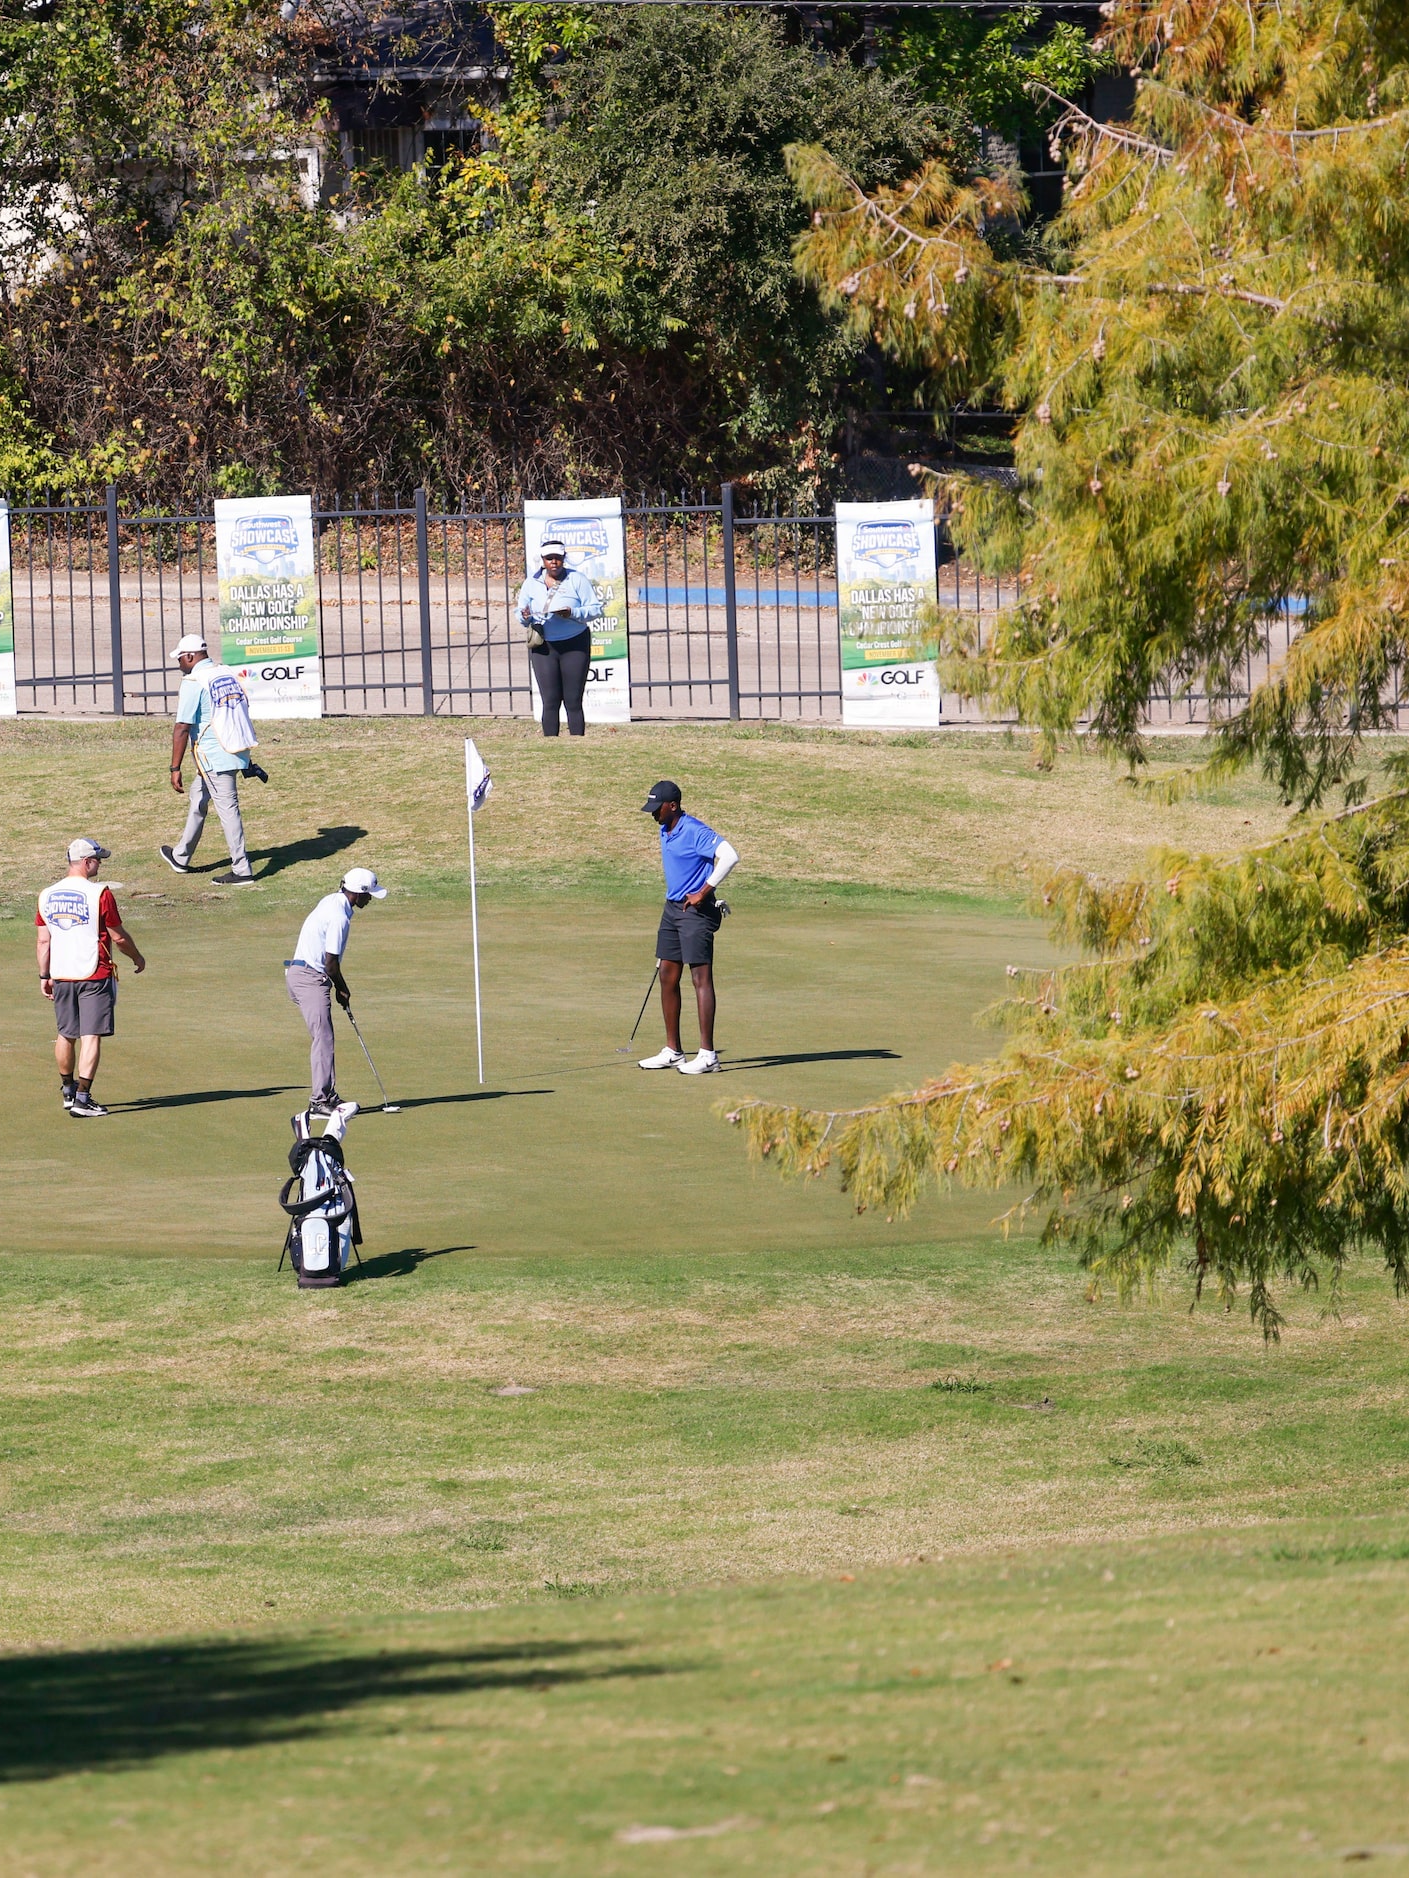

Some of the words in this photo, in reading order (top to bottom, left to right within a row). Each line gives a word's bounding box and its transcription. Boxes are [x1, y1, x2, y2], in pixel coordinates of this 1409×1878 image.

[241, 521, 282, 529] Southwest
[863, 525, 903, 533] Southwest
[231, 529, 298, 547] SHOWCASE
[852, 532, 920, 551] SHOWCASE
[230, 585, 270, 600] DALLAS
[272, 583, 294, 598] HAS
[296, 583, 304, 597] A
[606, 585, 614, 599] A
[851, 589, 891, 604] DALLAS
[893, 588, 915, 602] HAS
[917, 587, 925, 600] A
[241, 601, 265, 616] NEW
[268, 600, 294, 615] GOLF
[861, 605, 886, 619] NEW
[888, 604, 915, 619] GOLF
[228, 615, 308, 632] CHAMPIONSHIP
[236, 637, 252, 646] Cedar
[253, 637, 269, 645] Crest
[270, 635, 282, 644] Golf
[282, 635, 303, 643] Course
[856, 641, 873, 650] Cedar
[873, 641, 890, 649] Crest
[890, 639, 902, 648] Golf
[261, 666, 304, 681] GOLF
[587, 668, 613, 681] OLF
[881, 670, 925, 684] GOLF
[304, 1233, 327, 1255] LC
